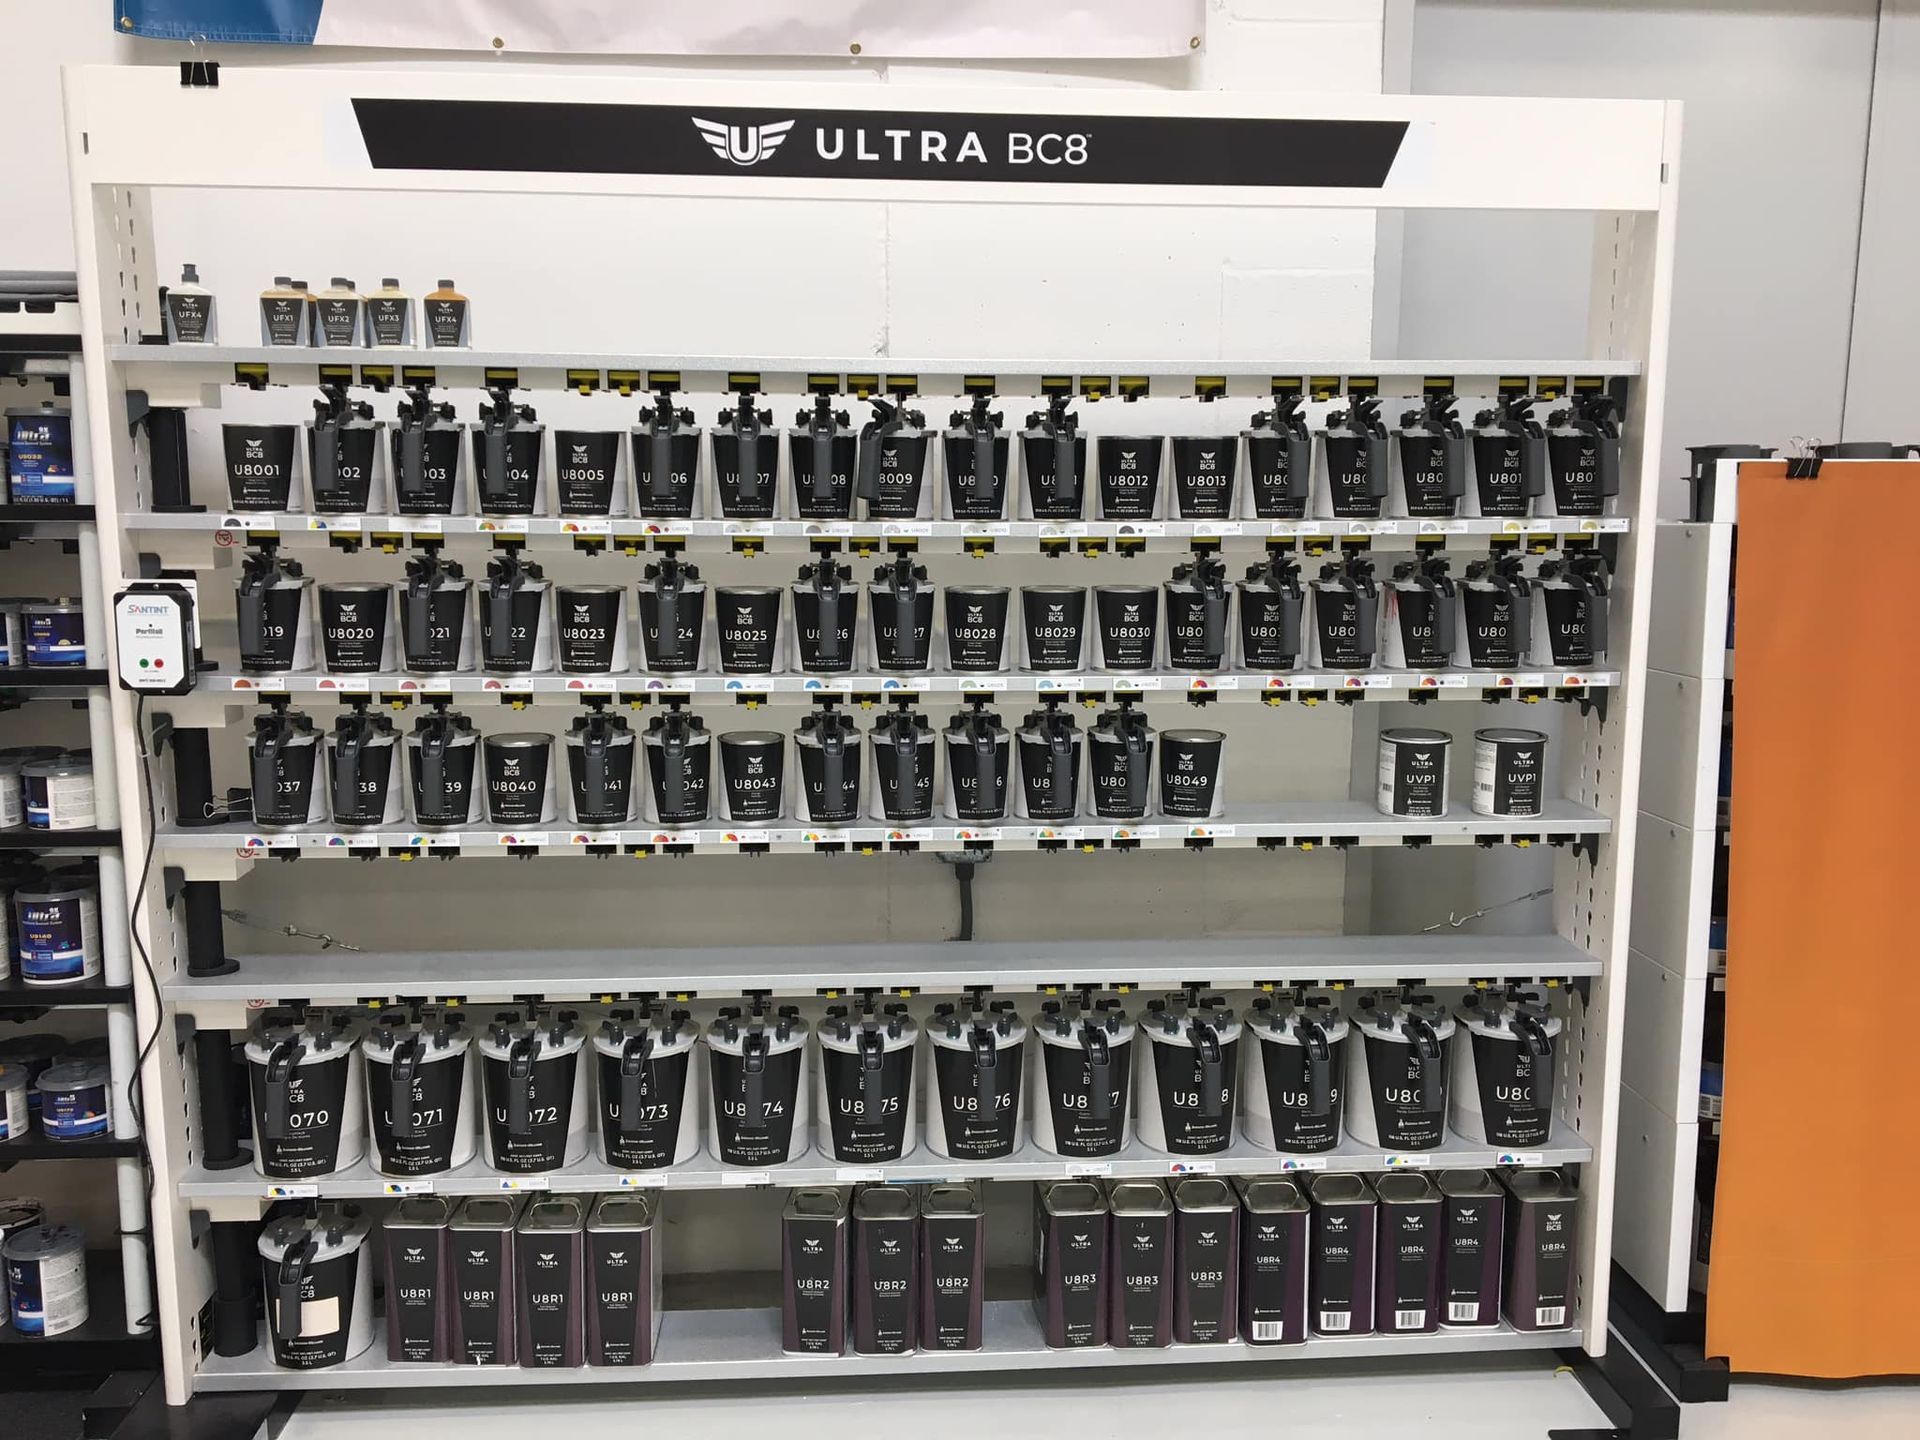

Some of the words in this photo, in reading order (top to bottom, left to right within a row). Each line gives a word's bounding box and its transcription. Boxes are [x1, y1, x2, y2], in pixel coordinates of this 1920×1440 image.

[816, 127, 987, 163] ULTRA
[1008, 133, 1089, 165] BC8
[273, 314, 293, 322] UFX1
[234, 464, 280, 476] U8001
[561, 469, 605, 481] U8005
[642, 472, 688, 484] U06
[802, 474, 846, 486] U08
[879, 473, 913, 484] 8009
[958, 475, 999, 486] U80
[1041, 475, 1078, 486] U81
[1109, 475, 1149, 486] U8012
[1187, 475, 1227, 487] U8013
[1263, 474, 1288, 486] U80
[1416, 472, 1443, 483] U80
[1489, 472, 1522, 484] U801
[1565, 471, 1594, 483] U80
[128, 604, 169, 614] SANTINT
[328, 628, 374, 639] U8020
[484, 626, 526, 638] U22
[563, 628, 606, 640] U8023
[650, 627, 693, 639] U24
[806, 628, 848, 640] U26
[954, 628, 997, 639] U8028
[1035, 627, 1076, 638] U8029
[1110, 627, 1151, 638] U8030
[1177, 626, 1204, 637] U80
[1250, 626, 1278, 638] U80
[1328, 626, 1356, 637] U80
[1478, 626, 1507, 637] U80
[1561, 623, 1585, 634] U80
[725, 630, 767, 641] U8025
[734, 777, 776, 790] U8043
[889, 777, 929, 790] U45
[961, 776, 1003, 788] U86
[1100, 775, 1126, 787] U80
[1166, 774, 1208, 787] U8049
[1406, 774, 1436, 784] UVP1
[1508, 773, 1536, 783] UVP1
[418, 782, 462, 793] U39
[491, 780, 536, 792] U8040
[580, 780, 622, 792] U41
[662, 778, 704, 791] U042
[814, 780, 855, 793] U44
[1407, 1071, 1420, 1079] BC
[1516, 1069, 1530, 1077] BC
[288, 1094, 305, 1103] C8
[1173, 1088, 1229, 1106] U88
[1283, 1088, 1338, 1106] U89
[1496, 1085, 1530, 1101] U80
[953, 1092, 1011, 1111] U876
[1062, 1091, 1120, 1108] U87
[609, 1103, 669, 1119] U73
[724, 1100, 784, 1116] U874
[840, 1097, 899, 1114] U875
[289, 1110, 329, 1128] 070
[384, 1108, 443, 1127] U071
[496, 1106, 557, 1123] U72
[1455, 1238, 1479, 1246] U8R4
[1541, 1243, 1566, 1251] U8R4
[1325, 1247, 1349, 1255] U8R4
[1256, 1256, 1280, 1264] U8R4
[1065, 1274, 1097, 1285] U8R3
[1126, 1276, 1159, 1286] U8R3
[1191, 1272, 1223, 1281] U8R3
[797, 1279, 830, 1289] U8R2
[874, 1280, 907, 1290] U8R2
[936, 1278, 969, 1287] U8R2
[301, 1290, 315, 1298] C8
[400, 1288, 431, 1298] U8R1
[464, 1291, 495, 1300] U8R1
[601, 1292, 633, 1303] U8R1
[532, 1294, 564, 1304] U8R1
